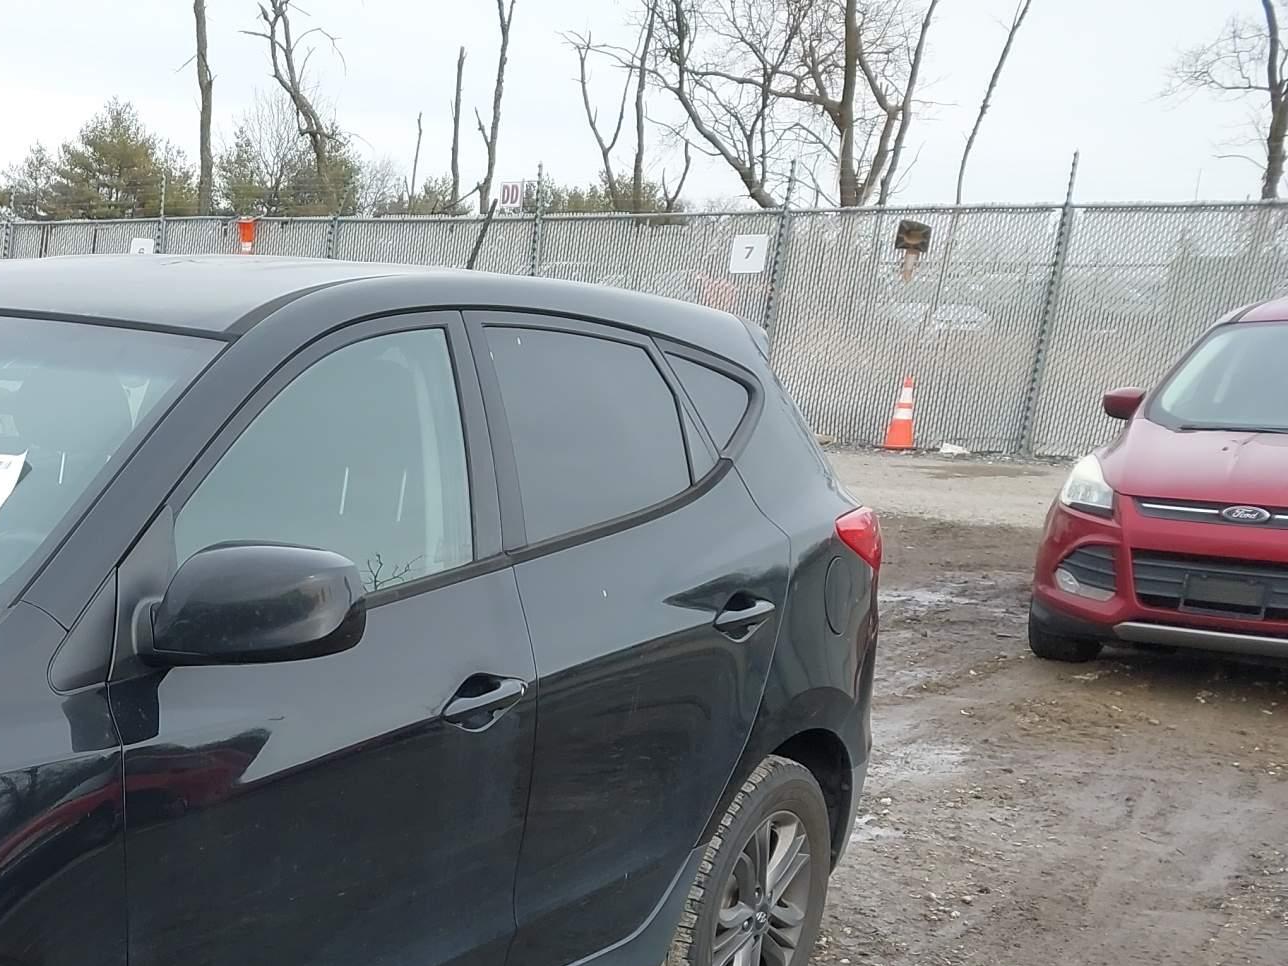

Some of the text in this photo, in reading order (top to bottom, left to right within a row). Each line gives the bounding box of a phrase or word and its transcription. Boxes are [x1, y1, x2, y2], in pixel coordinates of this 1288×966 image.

[501, 184, 520, 205] DD
[743, 246, 755, 260] 7
[1231, 508, 1259, 520] Ford
